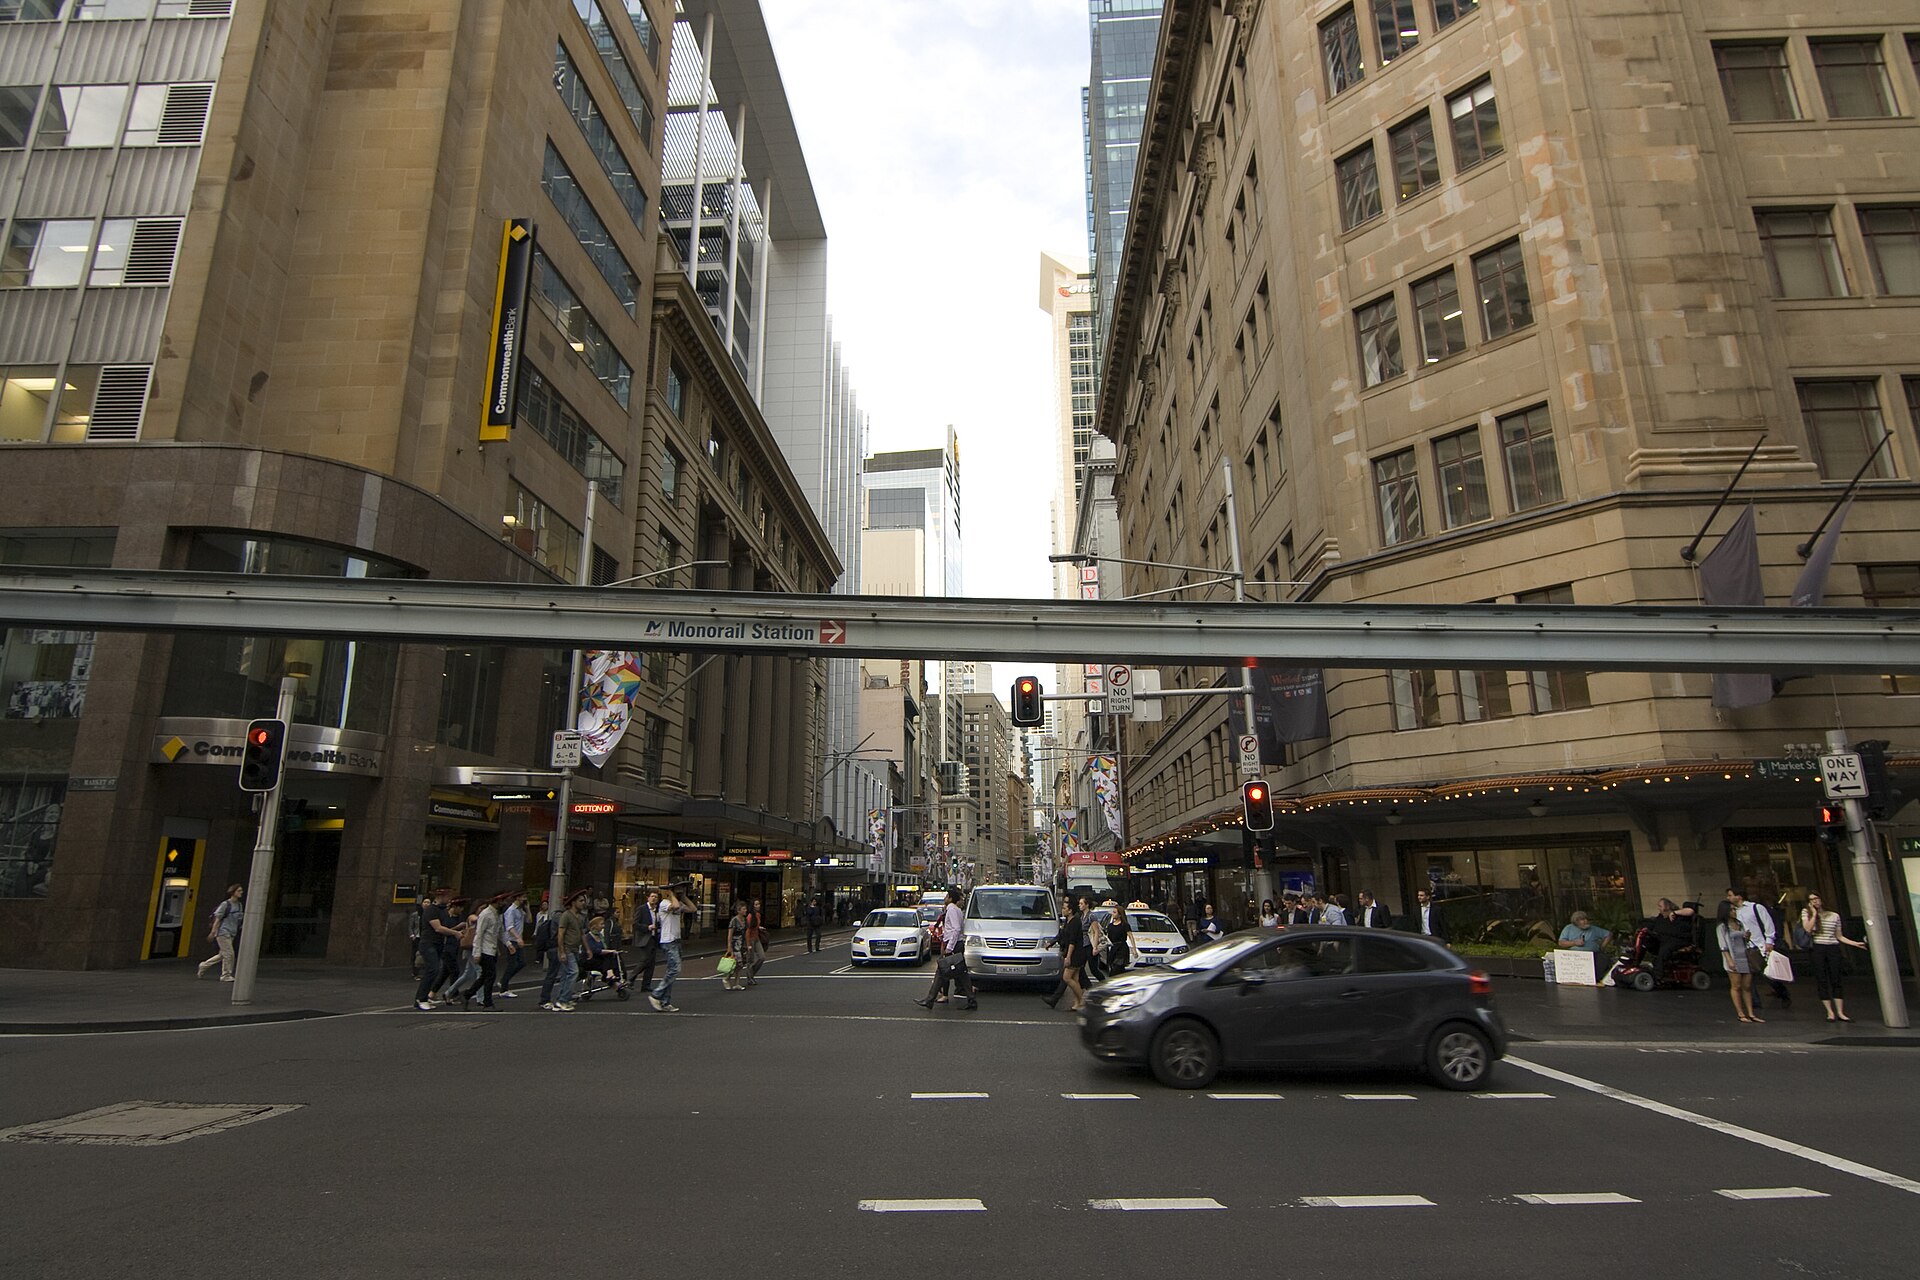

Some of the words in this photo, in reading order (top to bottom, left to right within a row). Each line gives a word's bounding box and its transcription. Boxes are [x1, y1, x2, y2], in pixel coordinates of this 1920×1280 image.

[668, 621, 745, 639] Monorail
[751, 622, 814, 641] Station
[1113, 688, 1127, 696] NO
[1770, 760, 1805, 771] Market
[1806, 760, 1817, 770] St
[1826, 757, 1856, 769] ONE
[1827, 771, 1858, 782] WAY
[574, 804, 602, 812] COTTON
[603, 804, 614, 812] ON
